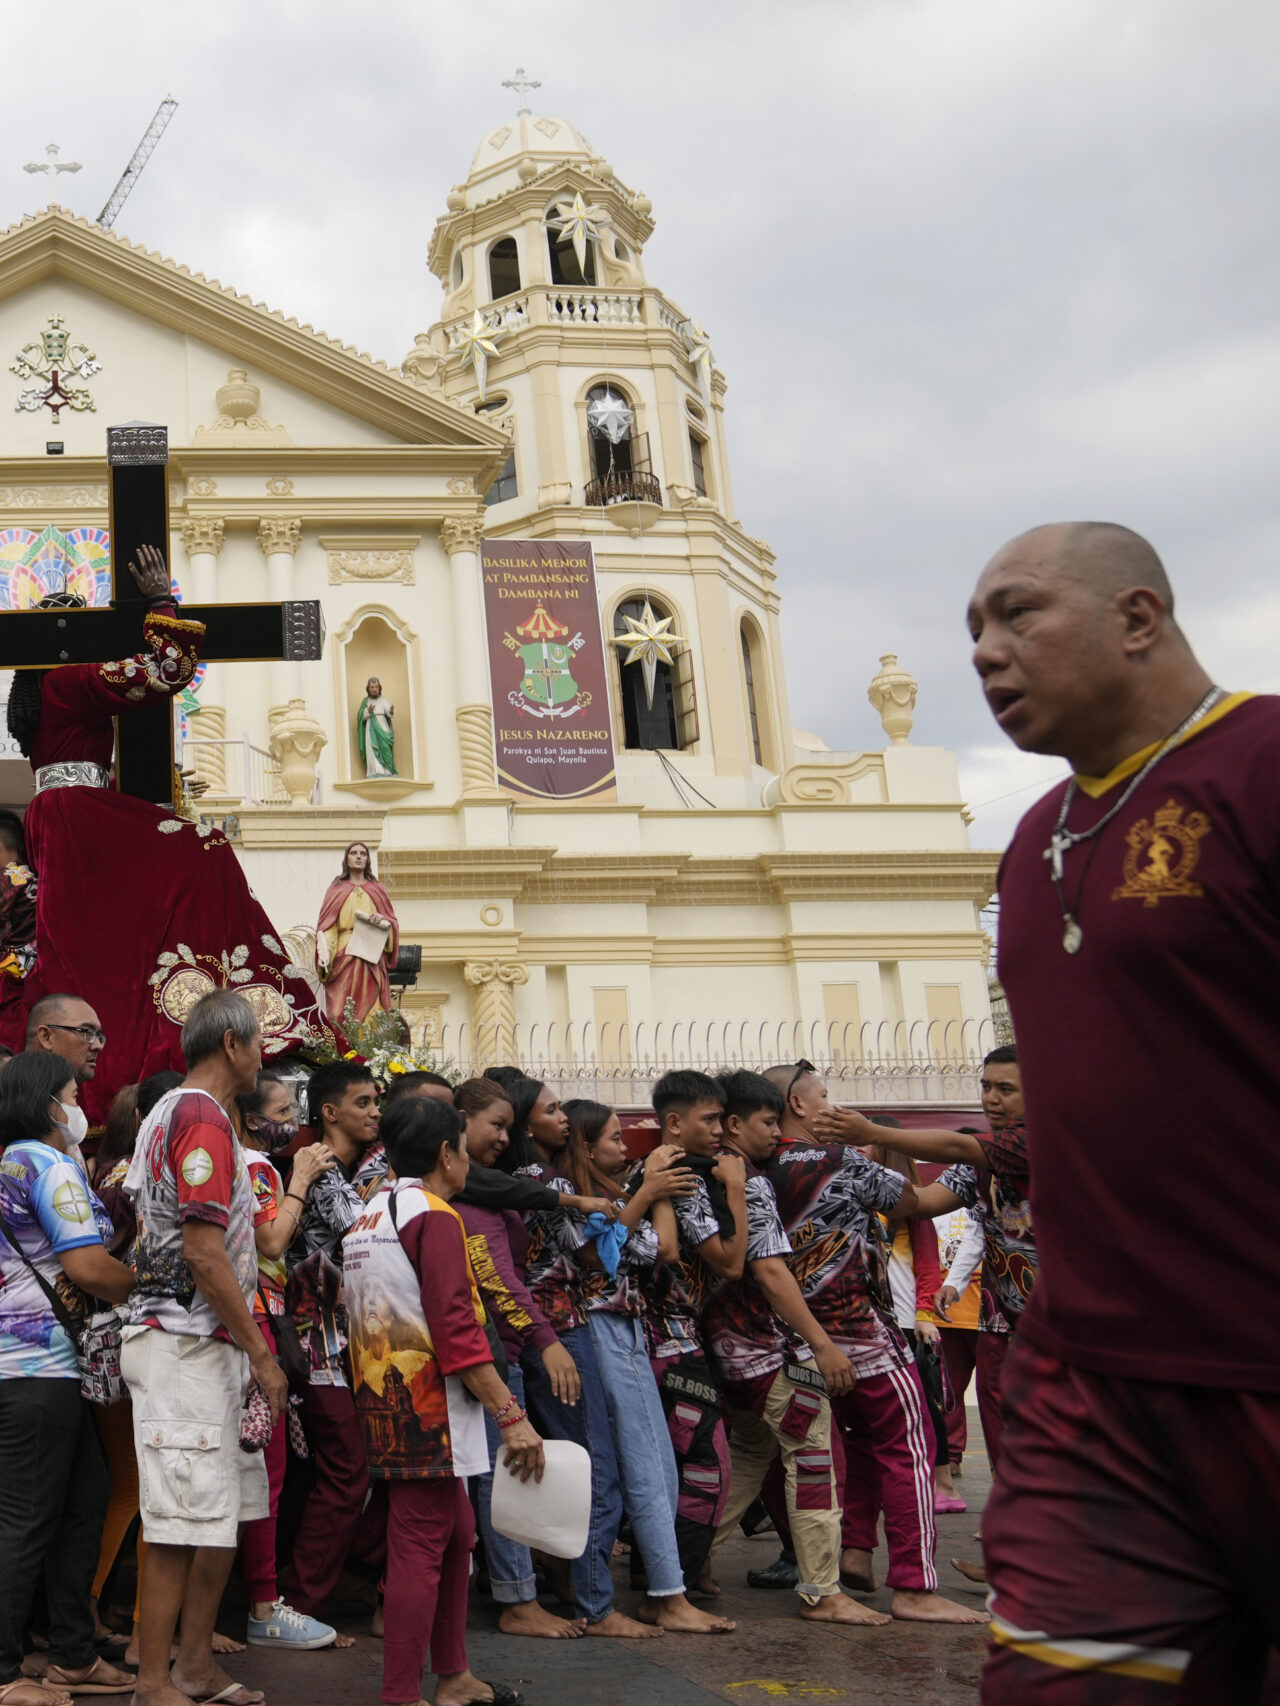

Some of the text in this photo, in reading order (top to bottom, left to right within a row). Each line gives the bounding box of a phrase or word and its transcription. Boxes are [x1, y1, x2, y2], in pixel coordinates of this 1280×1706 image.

[483, 557, 588, 568] BASILIKA MENOR
[485, 572, 589, 583] AT PAMBANSANG
[498, 587, 580, 599] DAMBANA NI
[499, 728, 609, 742] JESUS NAZARENO
[503, 746, 532, 756] Parokya
[544, 746, 557, 755] San
[559, 746, 576, 756] Juan
[579, 746, 608, 755] Bautista
[558, 755, 588, 765] Maynila
[466, 1234, 497, 1281] NAZARENO
[666, 1372, 717, 1402] SR.BOSS
